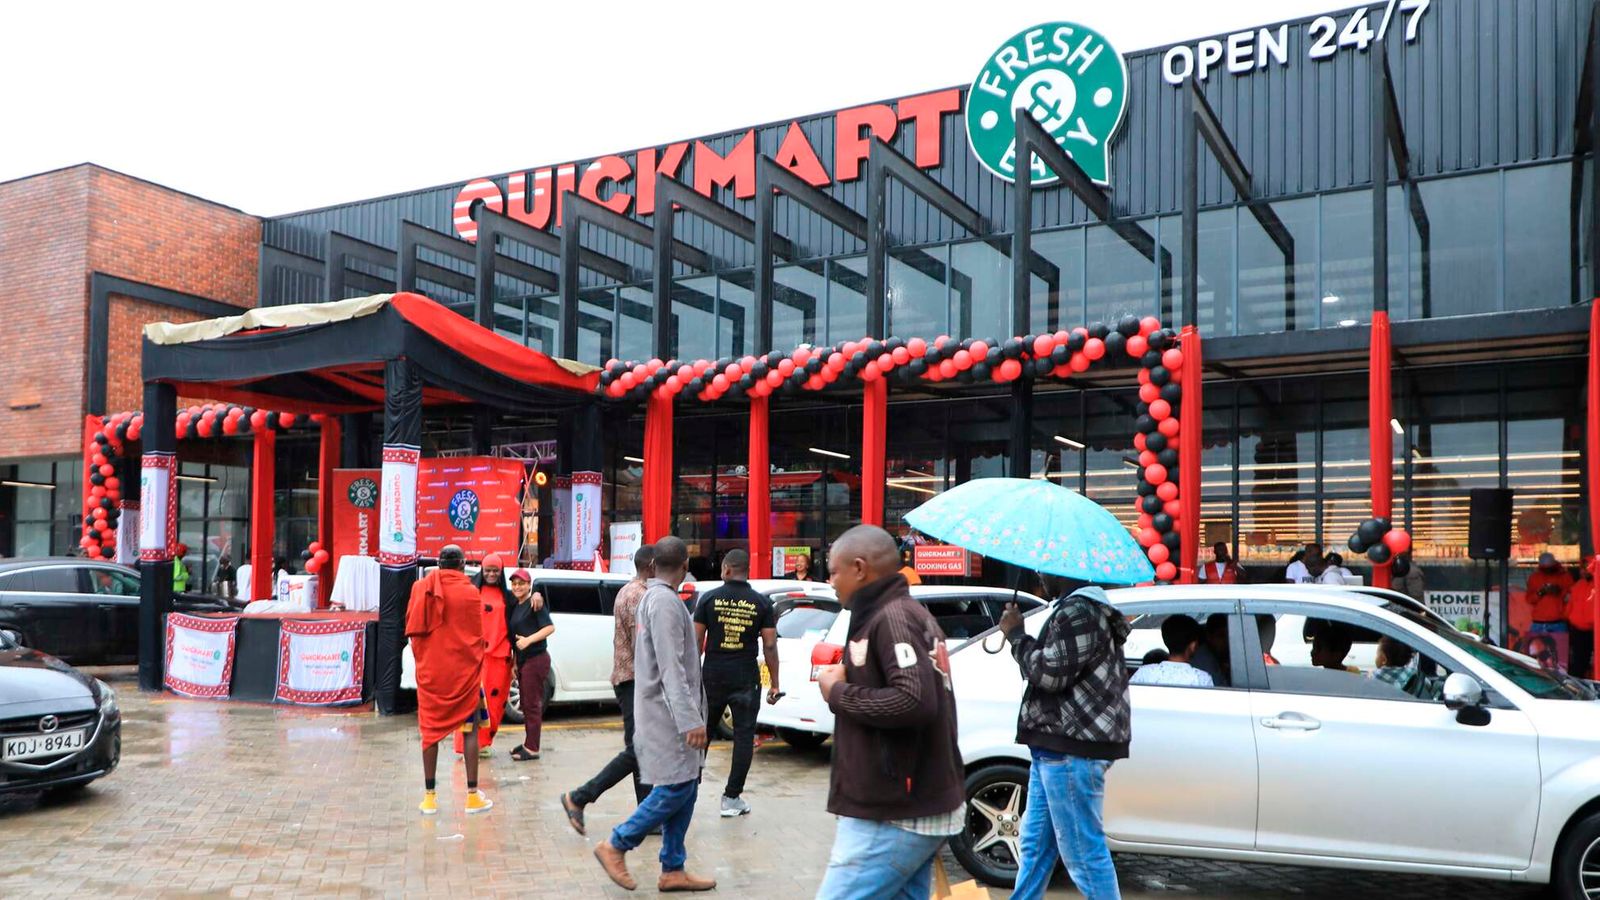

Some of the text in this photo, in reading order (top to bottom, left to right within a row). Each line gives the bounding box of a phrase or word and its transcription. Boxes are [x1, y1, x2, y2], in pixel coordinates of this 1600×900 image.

[1162, 0, 1430, 86] OPEN 24/7
[979, 26, 1104, 98] FRESH
[453, 88, 960, 244] QUICKMART
[350, 478, 376, 491] FRESH
[354, 497, 375, 508] EASY
[451, 489, 477, 508] FRESH
[453, 516, 474, 530] EASY
[358, 512, 369, 556] KMART
[1430, 594, 1481, 605] HOME
[1430, 606, 1481, 615] DELIVERY
[7, 733, 82, 757] KDJ 894J
